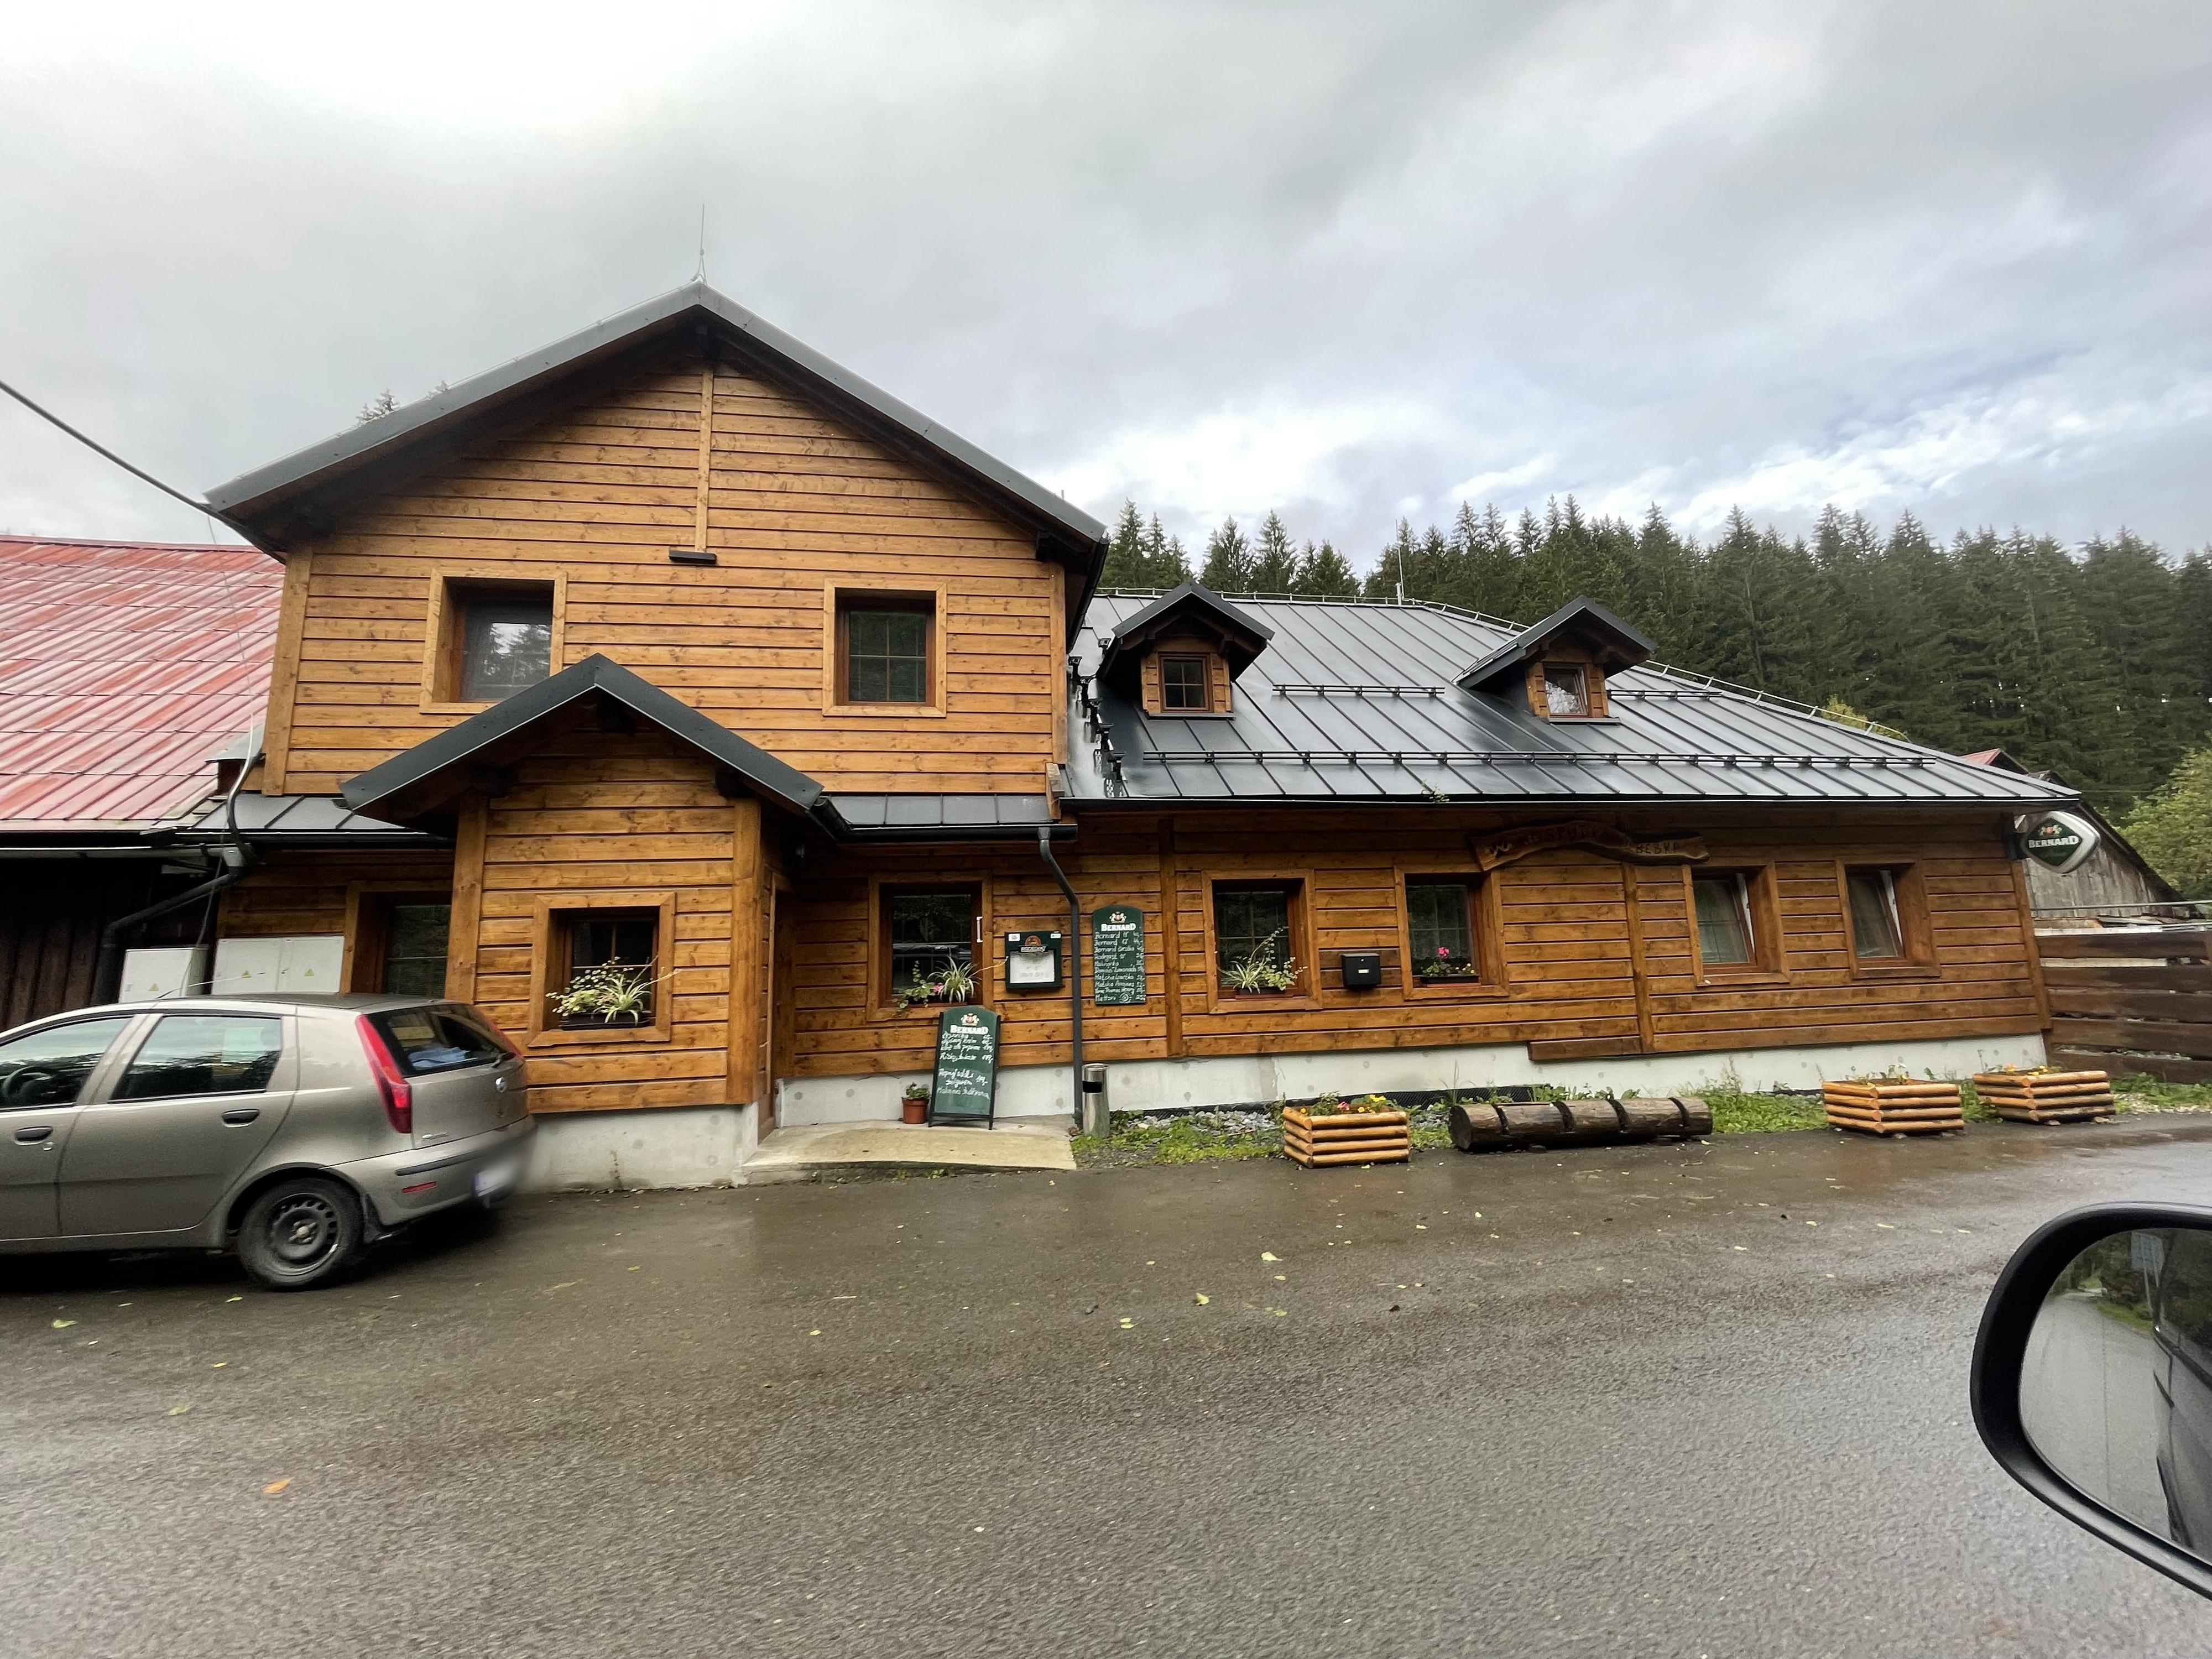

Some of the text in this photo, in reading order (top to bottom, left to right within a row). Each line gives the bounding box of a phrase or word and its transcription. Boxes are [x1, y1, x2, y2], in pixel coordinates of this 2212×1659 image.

[2028, 836, 2079, 848] BERNARD
[1101, 923, 1136, 931] BERNARD
[950, 1025, 989, 1035] BERNARD
